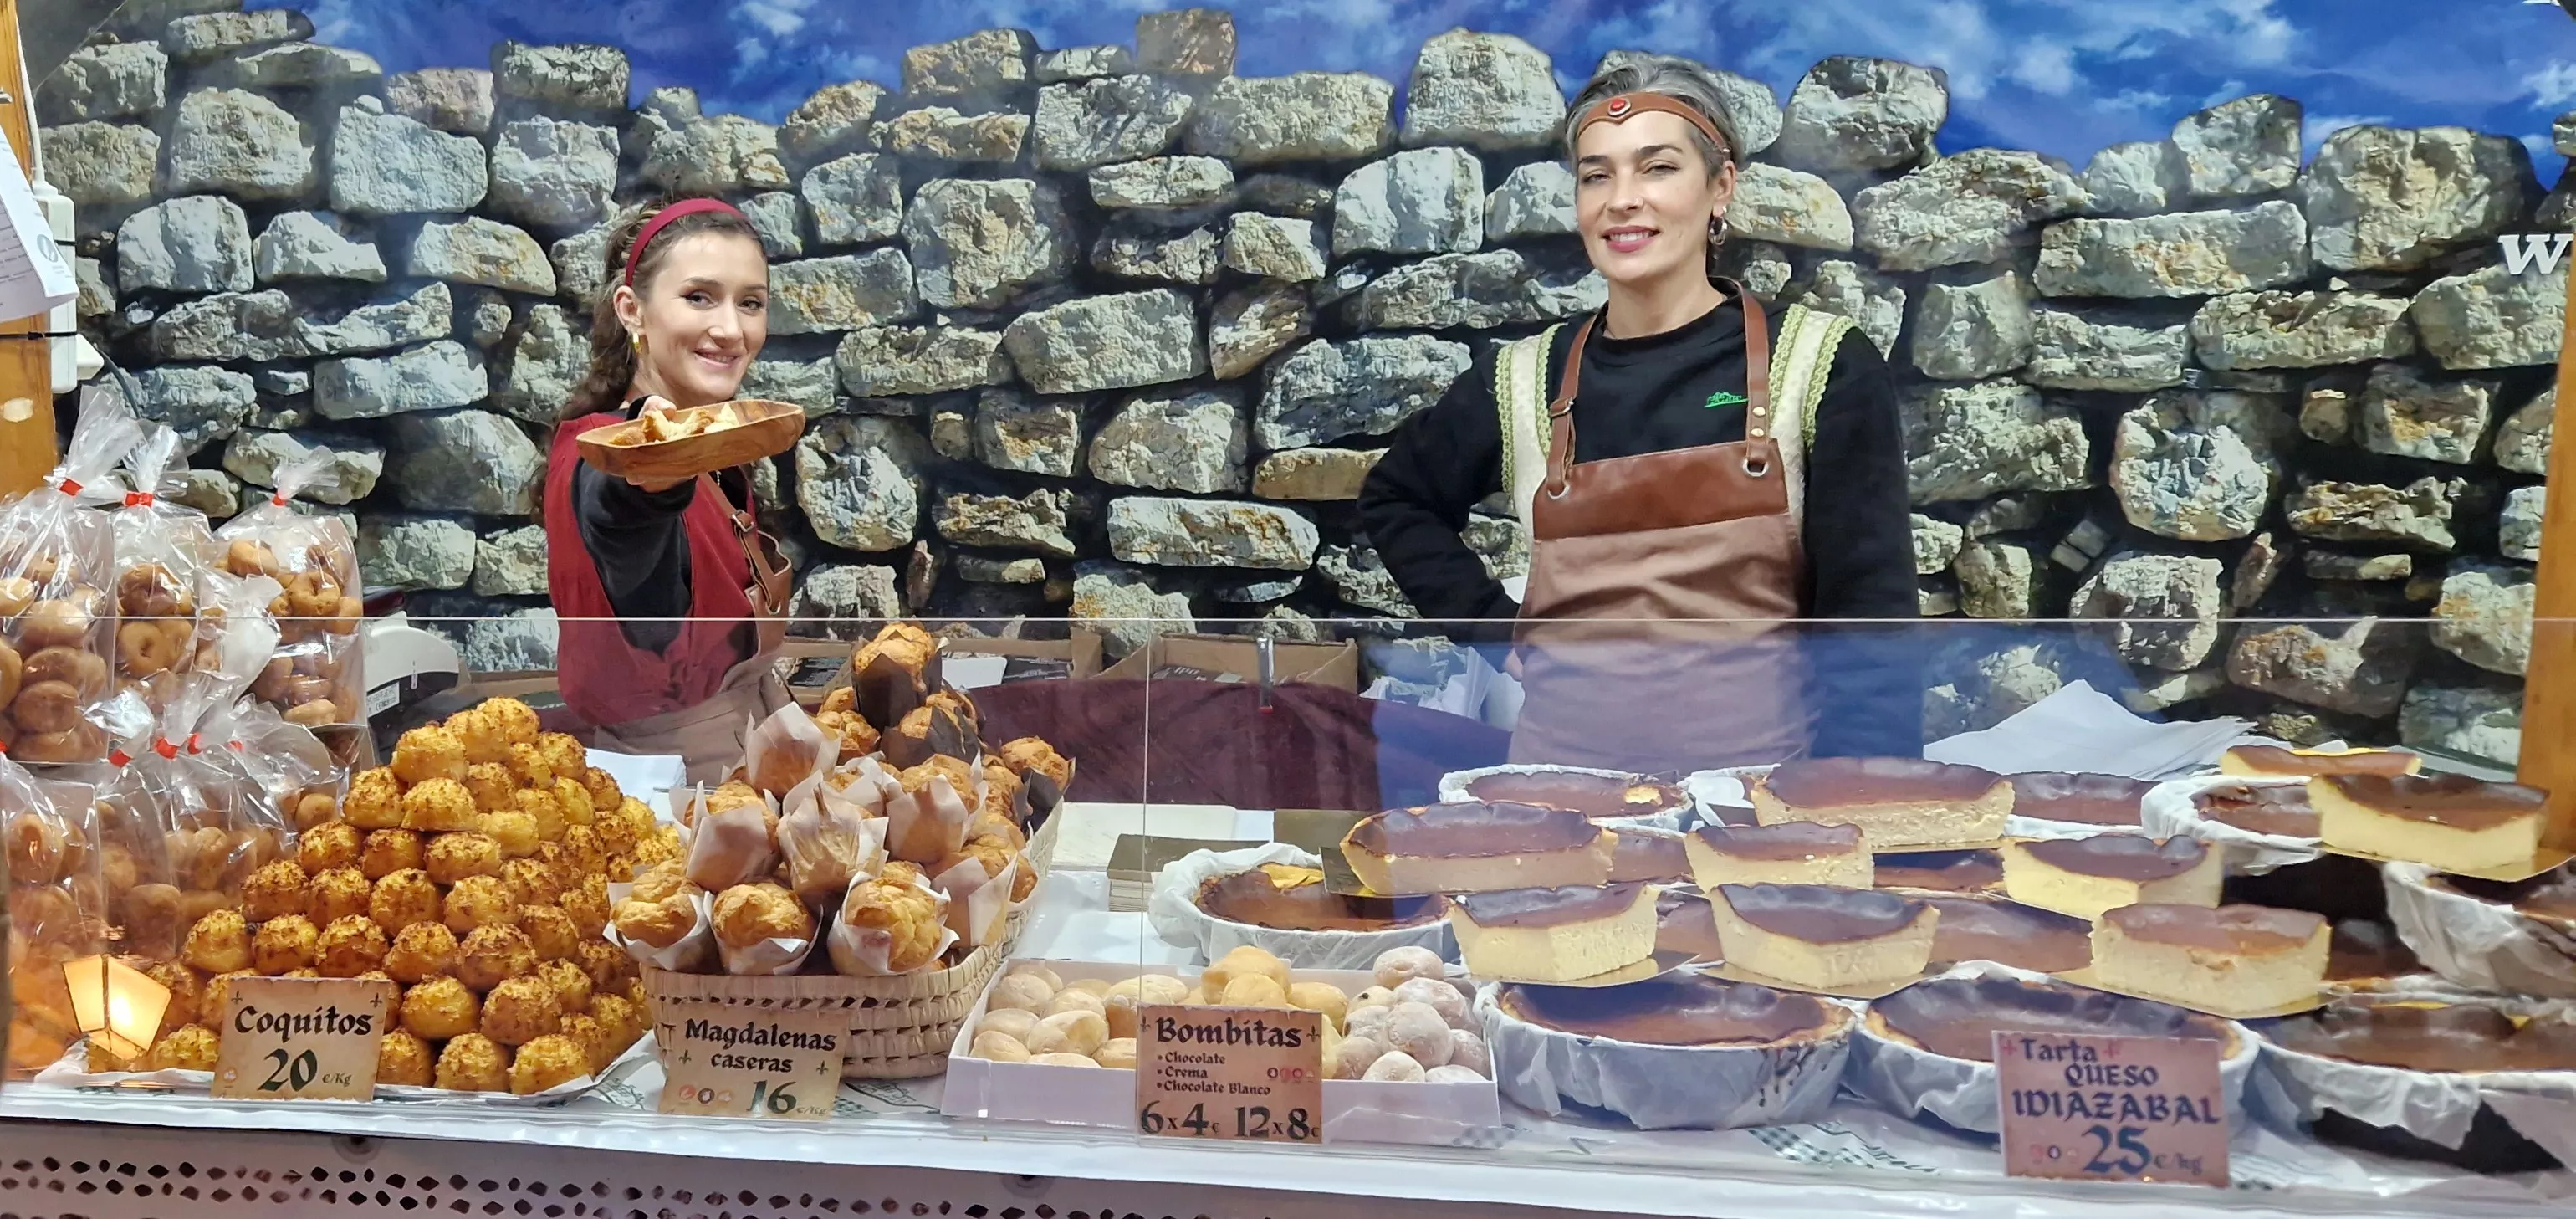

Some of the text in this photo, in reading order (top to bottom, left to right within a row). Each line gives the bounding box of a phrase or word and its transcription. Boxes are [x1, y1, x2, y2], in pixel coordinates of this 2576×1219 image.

[235, 1005, 374, 1043] Coquitos
[685, 1018, 837, 1051] Magdalenas
[1155, 1016, 1302, 1047] Bombitas
[711, 1053, 794, 1073] caseras
[1165, 1052, 1225, 1064] Chocolate
[2020, 1037, 2098, 1063] Tarta
[257, 1048, 318, 1092] 20
[1165, 1067, 1208, 1078] Crema
[2064, 1063, 2159, 1088] QUESO
[746, 1079, 797, 1114] 16
[1164, 1080, 1271, 1096] Chocolate Blanco
[2012, 1089, 2221, 1126] IDIAZABAL
[2081, 1124, 2152, 1175] 25
